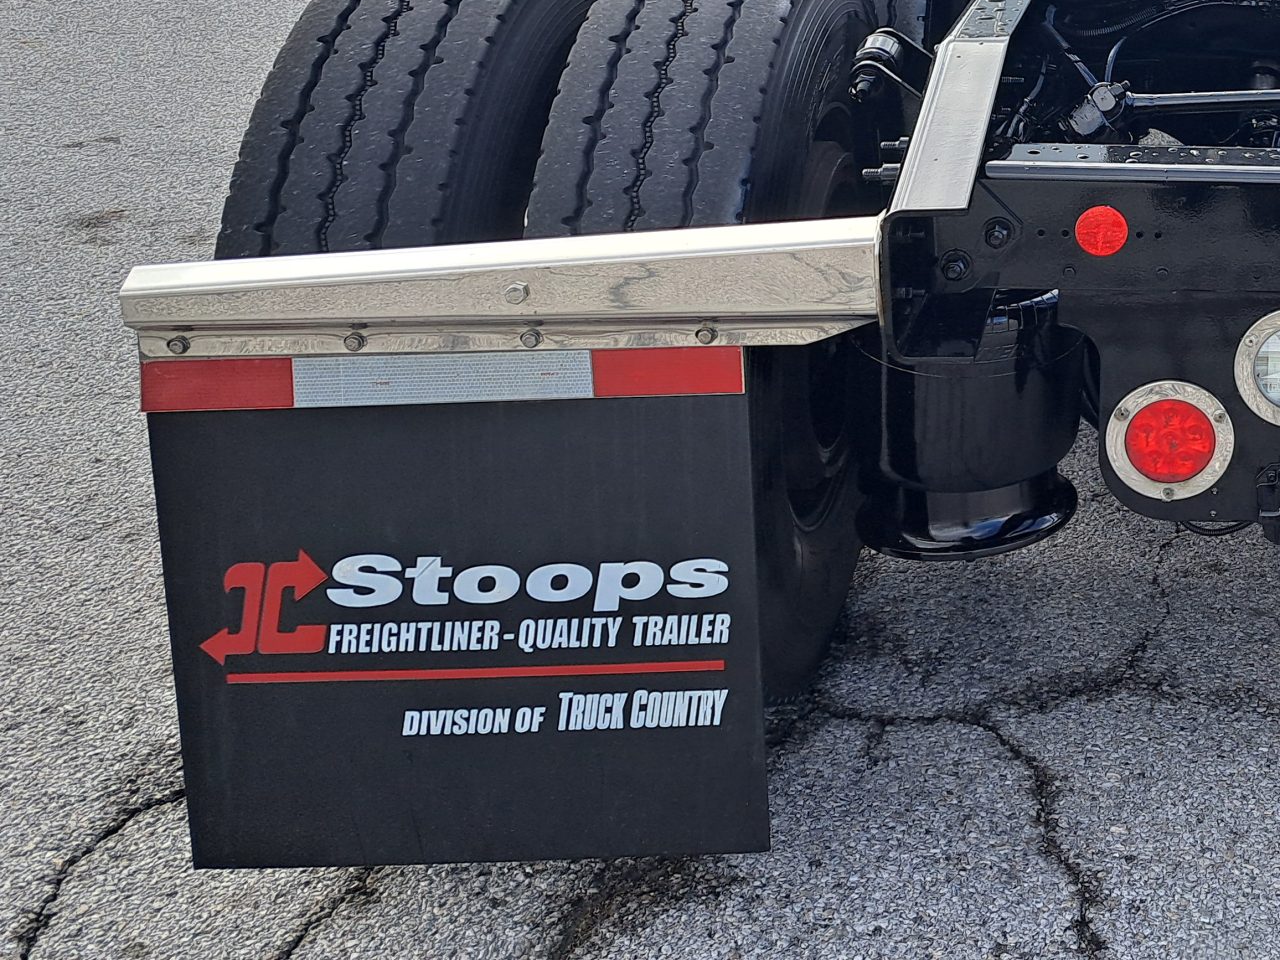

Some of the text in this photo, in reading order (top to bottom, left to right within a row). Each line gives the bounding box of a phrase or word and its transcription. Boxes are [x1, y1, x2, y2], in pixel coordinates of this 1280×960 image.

[326, 553, 730, 613] Stoops
[632, 613, 732, 647] TRAILER
[402, 689, 729, 736] DIVISION OF TRUCK COUNTRY
